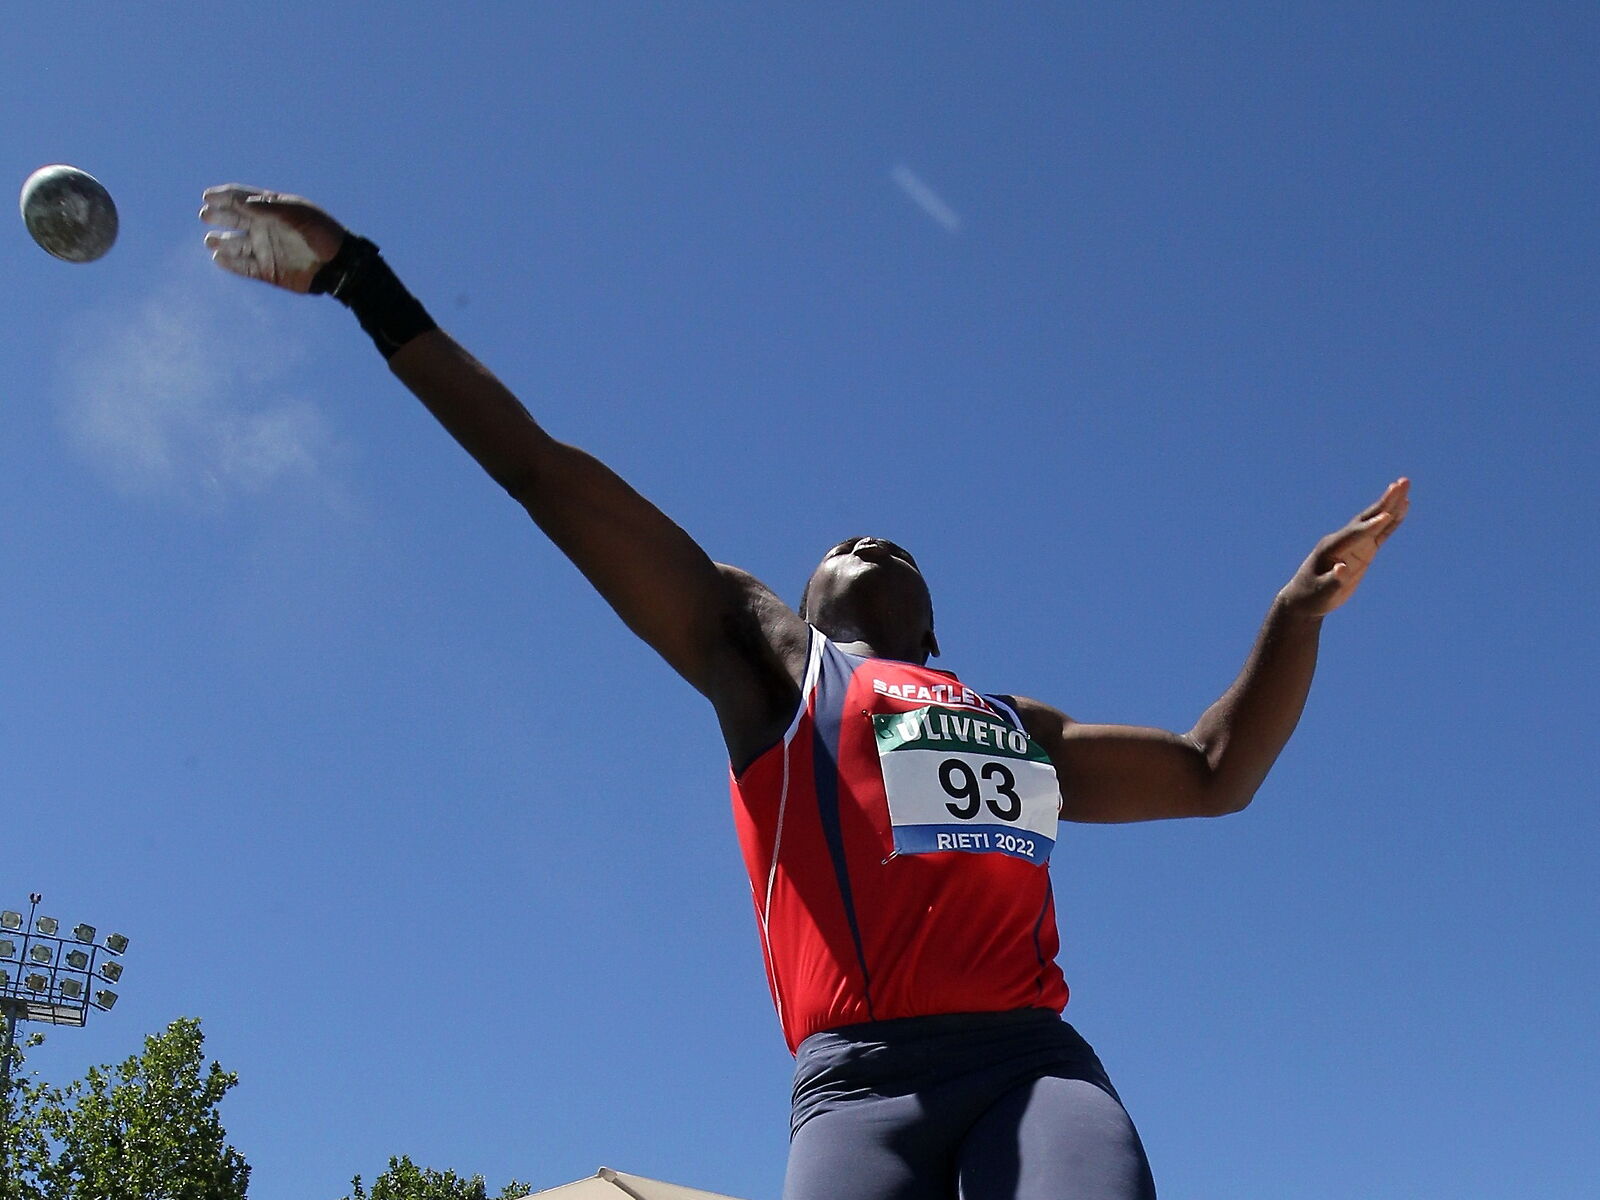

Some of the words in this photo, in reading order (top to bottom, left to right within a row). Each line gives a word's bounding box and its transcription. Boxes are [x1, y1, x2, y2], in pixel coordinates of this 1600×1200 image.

[896, 713, 1028, 755] ULIVETO
[938, 758, 1022, 822] 93
[937, 833, 990, 851] RIETI
[995, 833, 1036, 857] 2022
